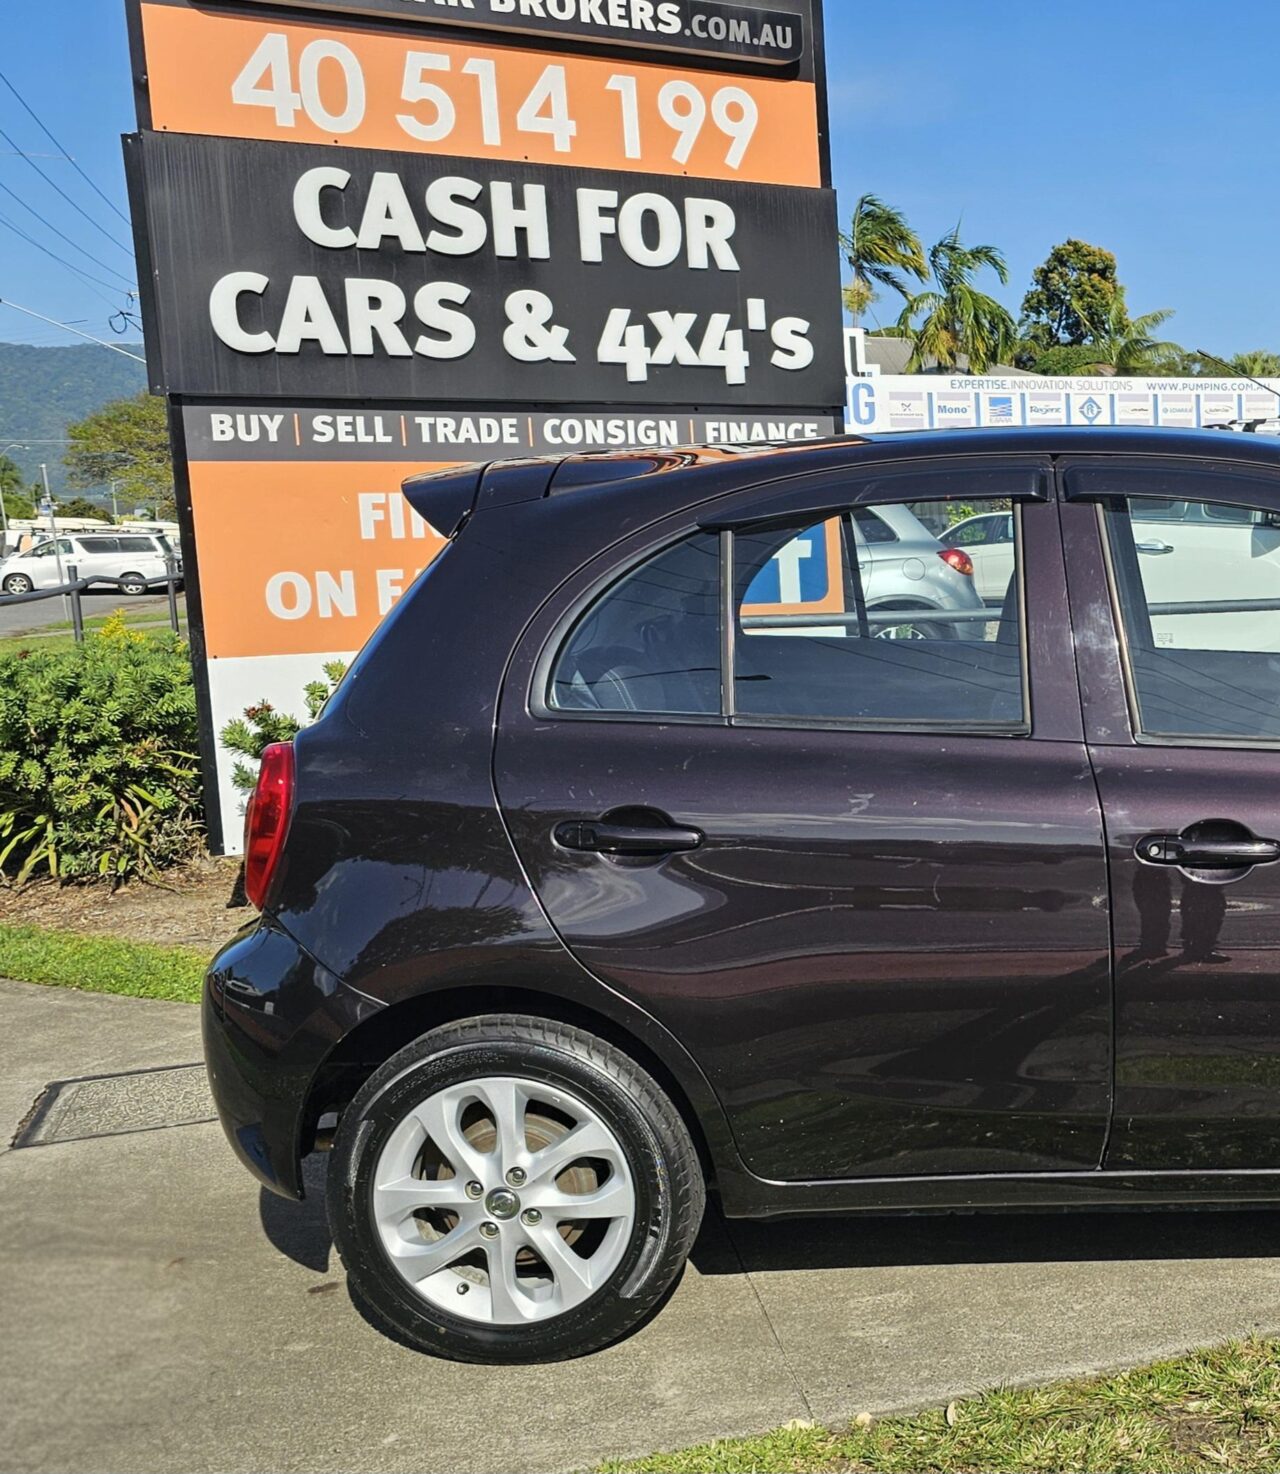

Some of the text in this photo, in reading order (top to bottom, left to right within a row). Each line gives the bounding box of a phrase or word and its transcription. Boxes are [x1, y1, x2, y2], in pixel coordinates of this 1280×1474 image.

[231, 32, 759, 171] 40 514 199
[293, 166, 740, 272] CASH FOR
[209, 271, 477, 361] CARS
[504, 290, 576, 363] &
[211, 413, 284, 442] BUY
[312, 415, 393, 444] SELL
[415, 416, 520, 444] TRADE
[543, 418, 679, 447] CONSIGN
[937, 405, 968, 414] Mono
[266, 571, 357, 620] ON
